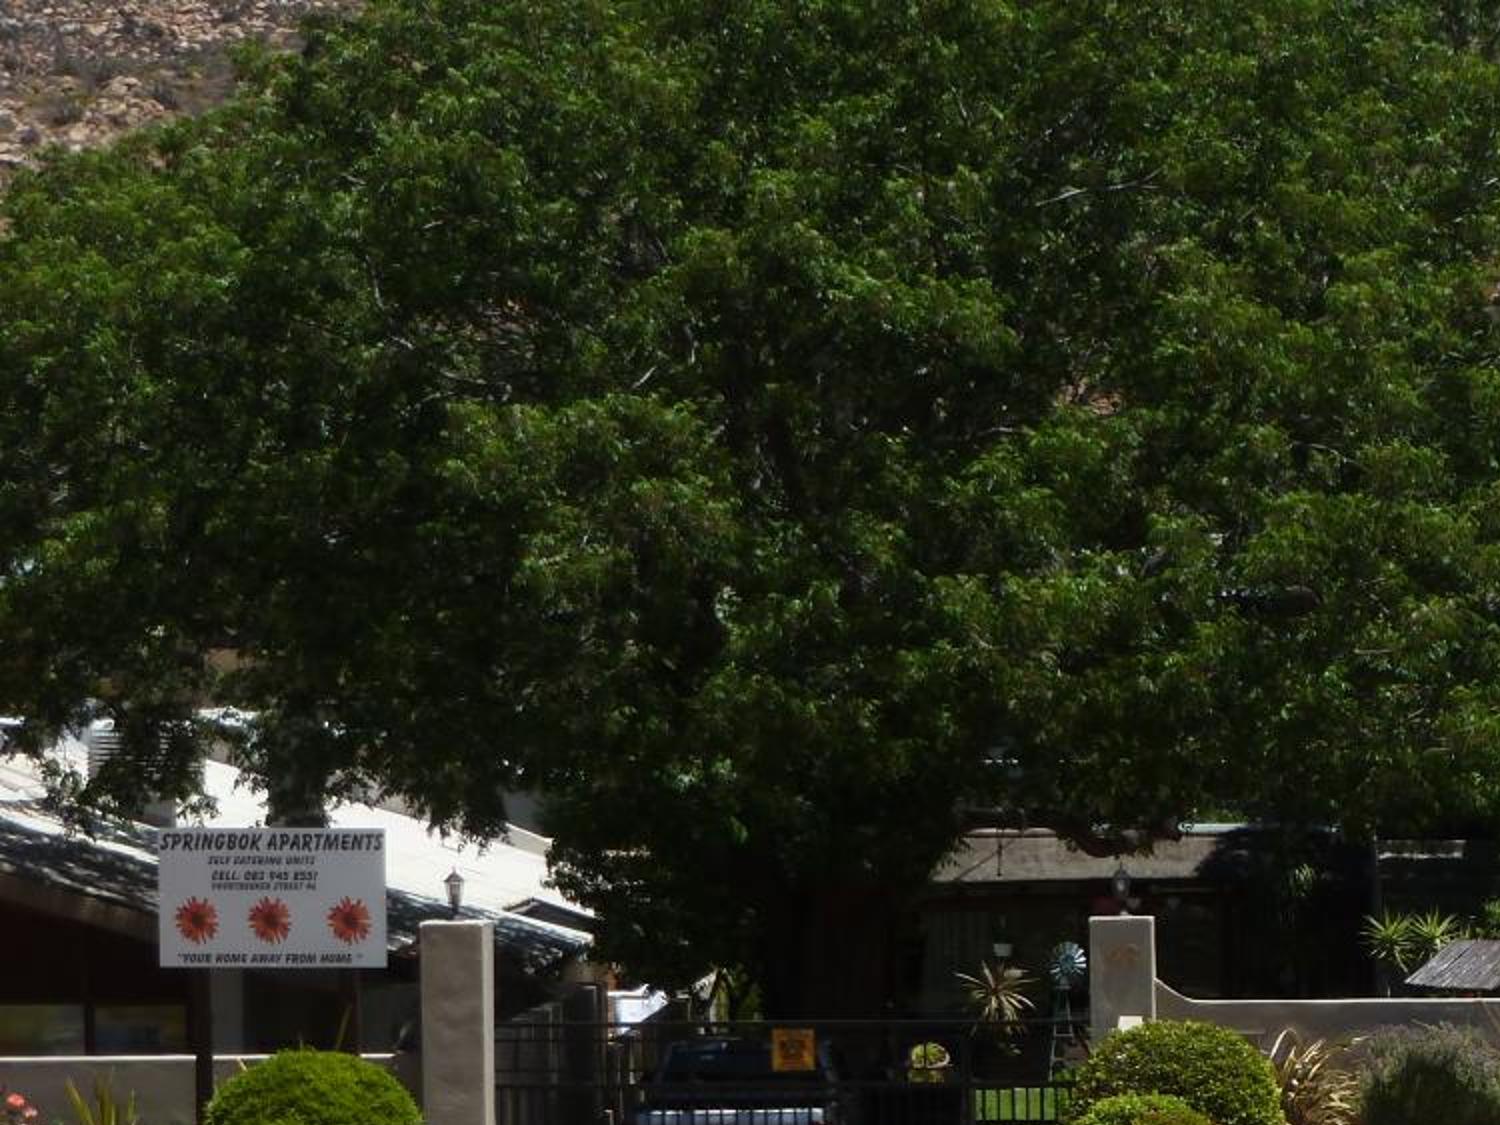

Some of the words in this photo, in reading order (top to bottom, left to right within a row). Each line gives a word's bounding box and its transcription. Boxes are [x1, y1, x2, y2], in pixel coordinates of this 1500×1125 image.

[160, 832, 262, 851] SPRINGBOK
[267, 832, 384, 852] APARTMENTS
[215, 953, 248, 963] HOME
[250, 953, 281, 963] AWAY
[285, 953, 317, 963] FROM
